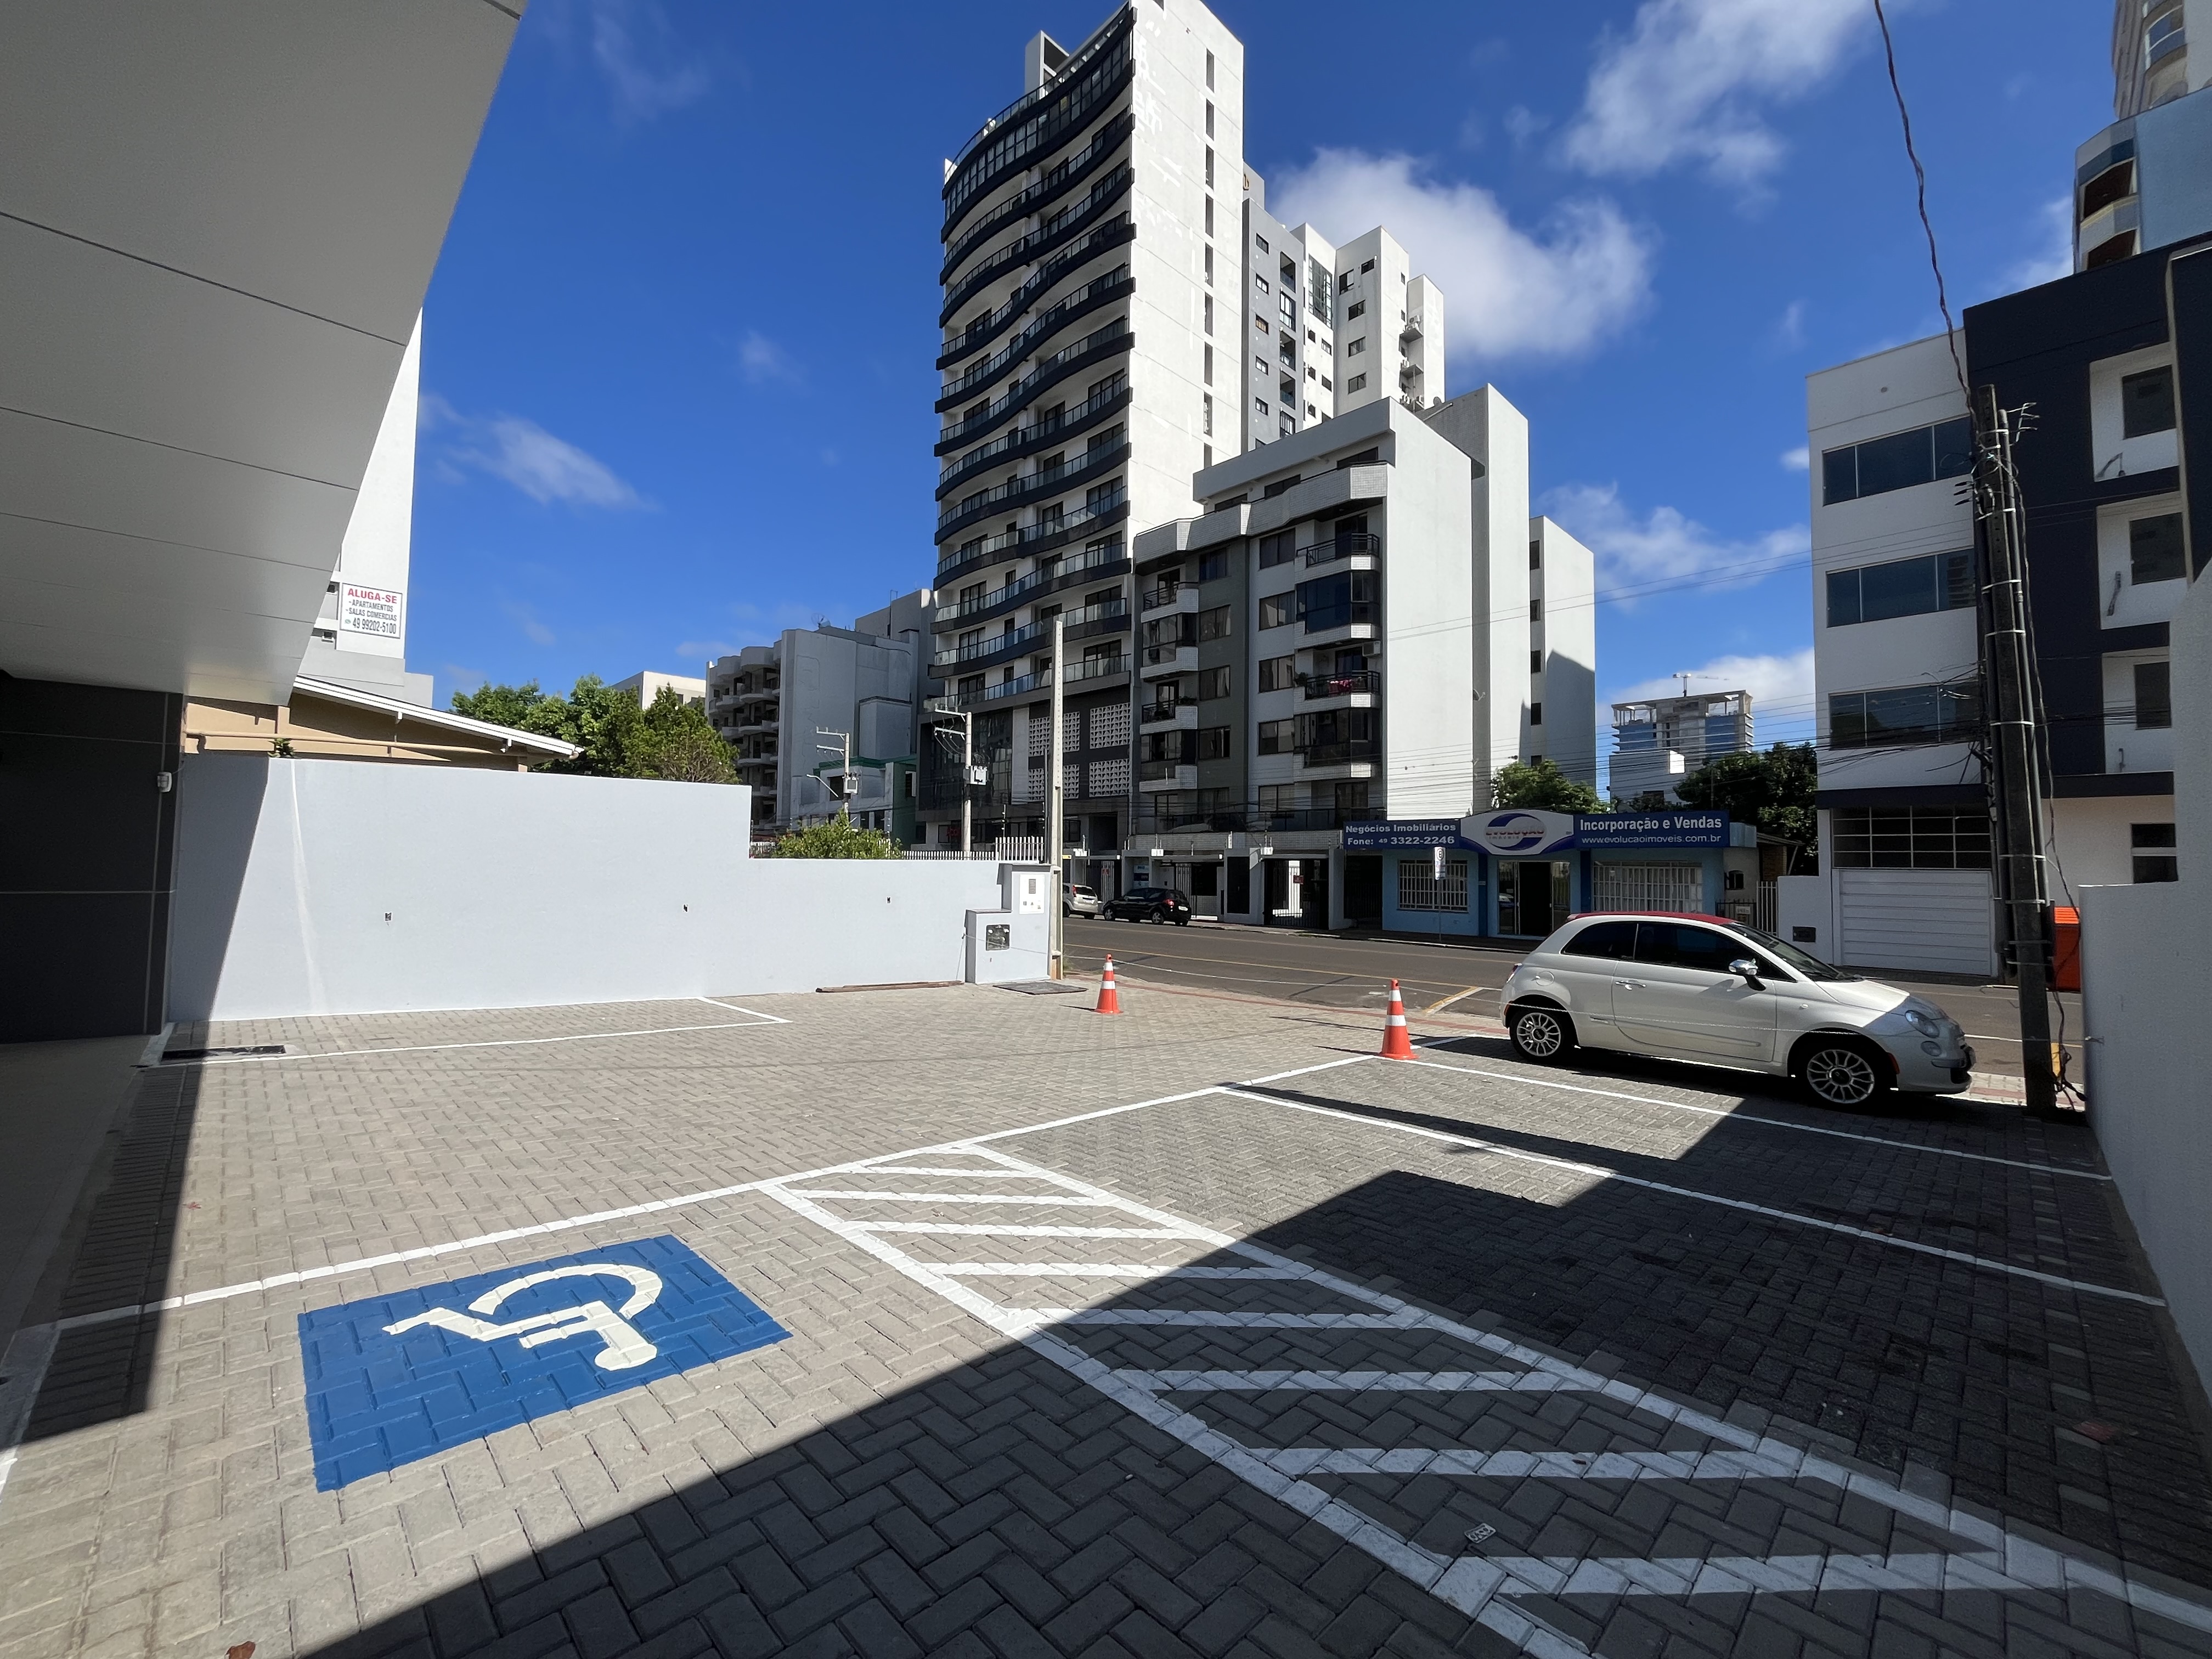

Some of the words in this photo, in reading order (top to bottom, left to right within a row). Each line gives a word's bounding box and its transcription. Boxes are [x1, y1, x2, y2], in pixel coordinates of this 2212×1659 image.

[348, 588, 397, 604] ALUGA-SE
[352, 617, 360, 629] 49
[362, 619, 397, 634] 99202-5100
[1346, 825, 1390, 834] Negócios
[1393, 823, 1456, 832] Imobiliários
[1581, 818, 1659, 833] Incorporação
[1663, 820, 1670, 828] e
[1674, 816, 1722, 829] Vendas
[1391, 836, 1455, 844] 3322-2246
[1582, 834, 1722, 843] www.evolucaoimoveis.com.br
